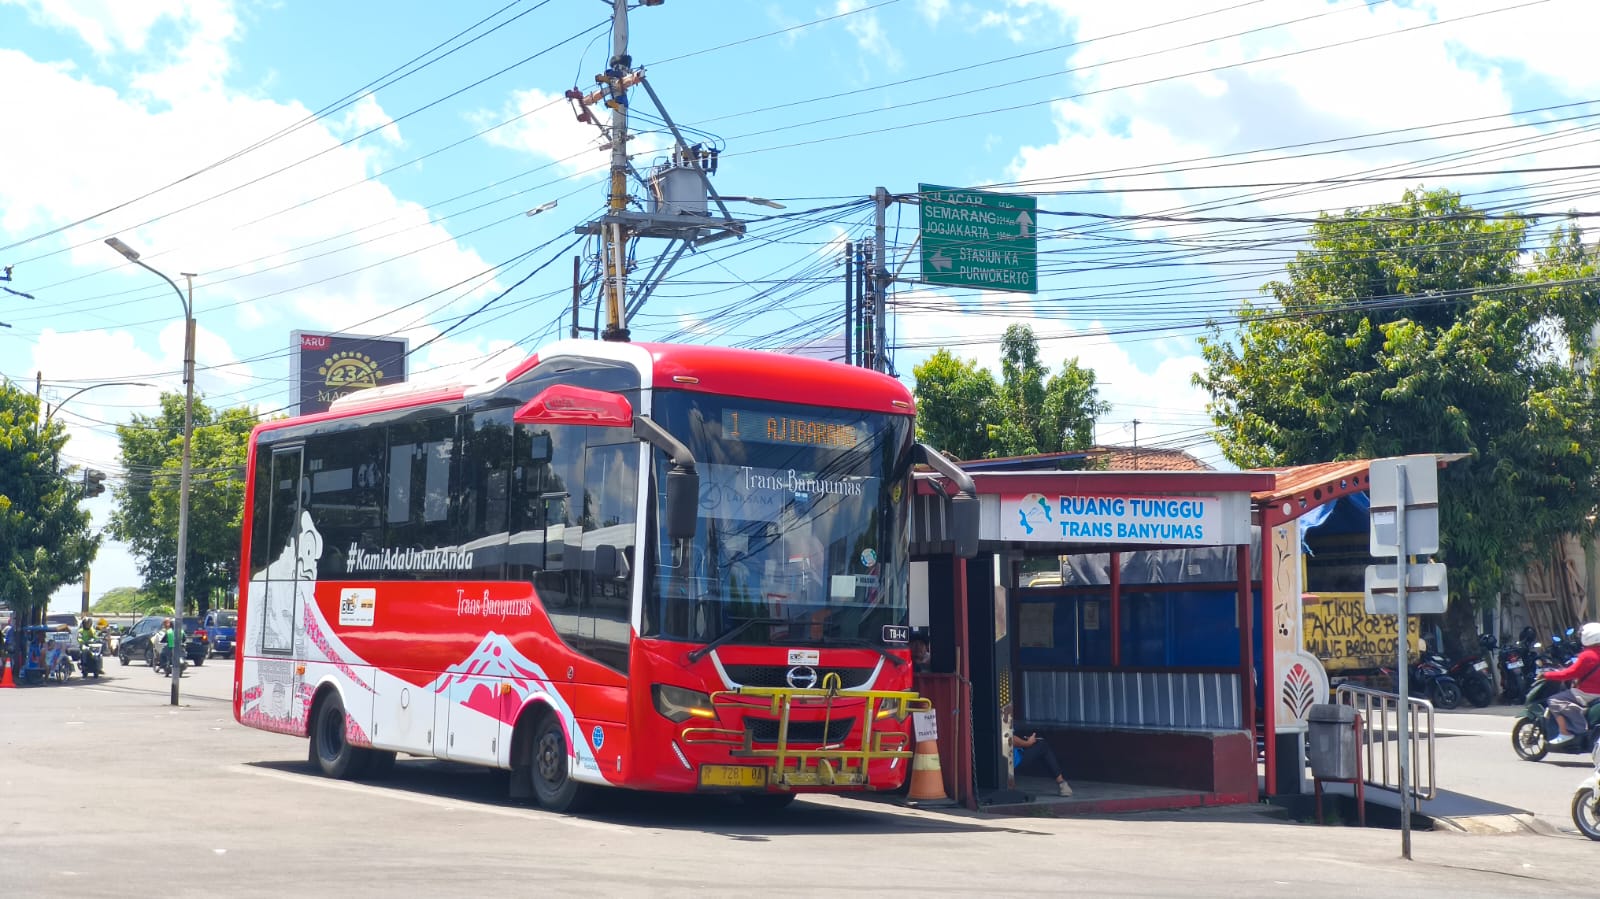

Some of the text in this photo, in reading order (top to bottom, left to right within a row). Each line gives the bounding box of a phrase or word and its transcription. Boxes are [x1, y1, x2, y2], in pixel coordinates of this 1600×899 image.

[925, 205, 997, 224] SEMARANG
[926, 221, 990, 239] JOGJAKARTA
[960, 247, 1001, 264] STASIUN
[960, 265, 1029, 285] PURWOKERTO
[741, 466, 862, 498] Trans Banyumas
[1060, 496, 1204, 519] RUANG TUNGGU
[1060, 521, 1204, 539] TRANS BANYUMAS
[346, 541, 474, 573] #KamiAdaUntukAnda
[456, 589, 532, 623] Trans Banyumas
